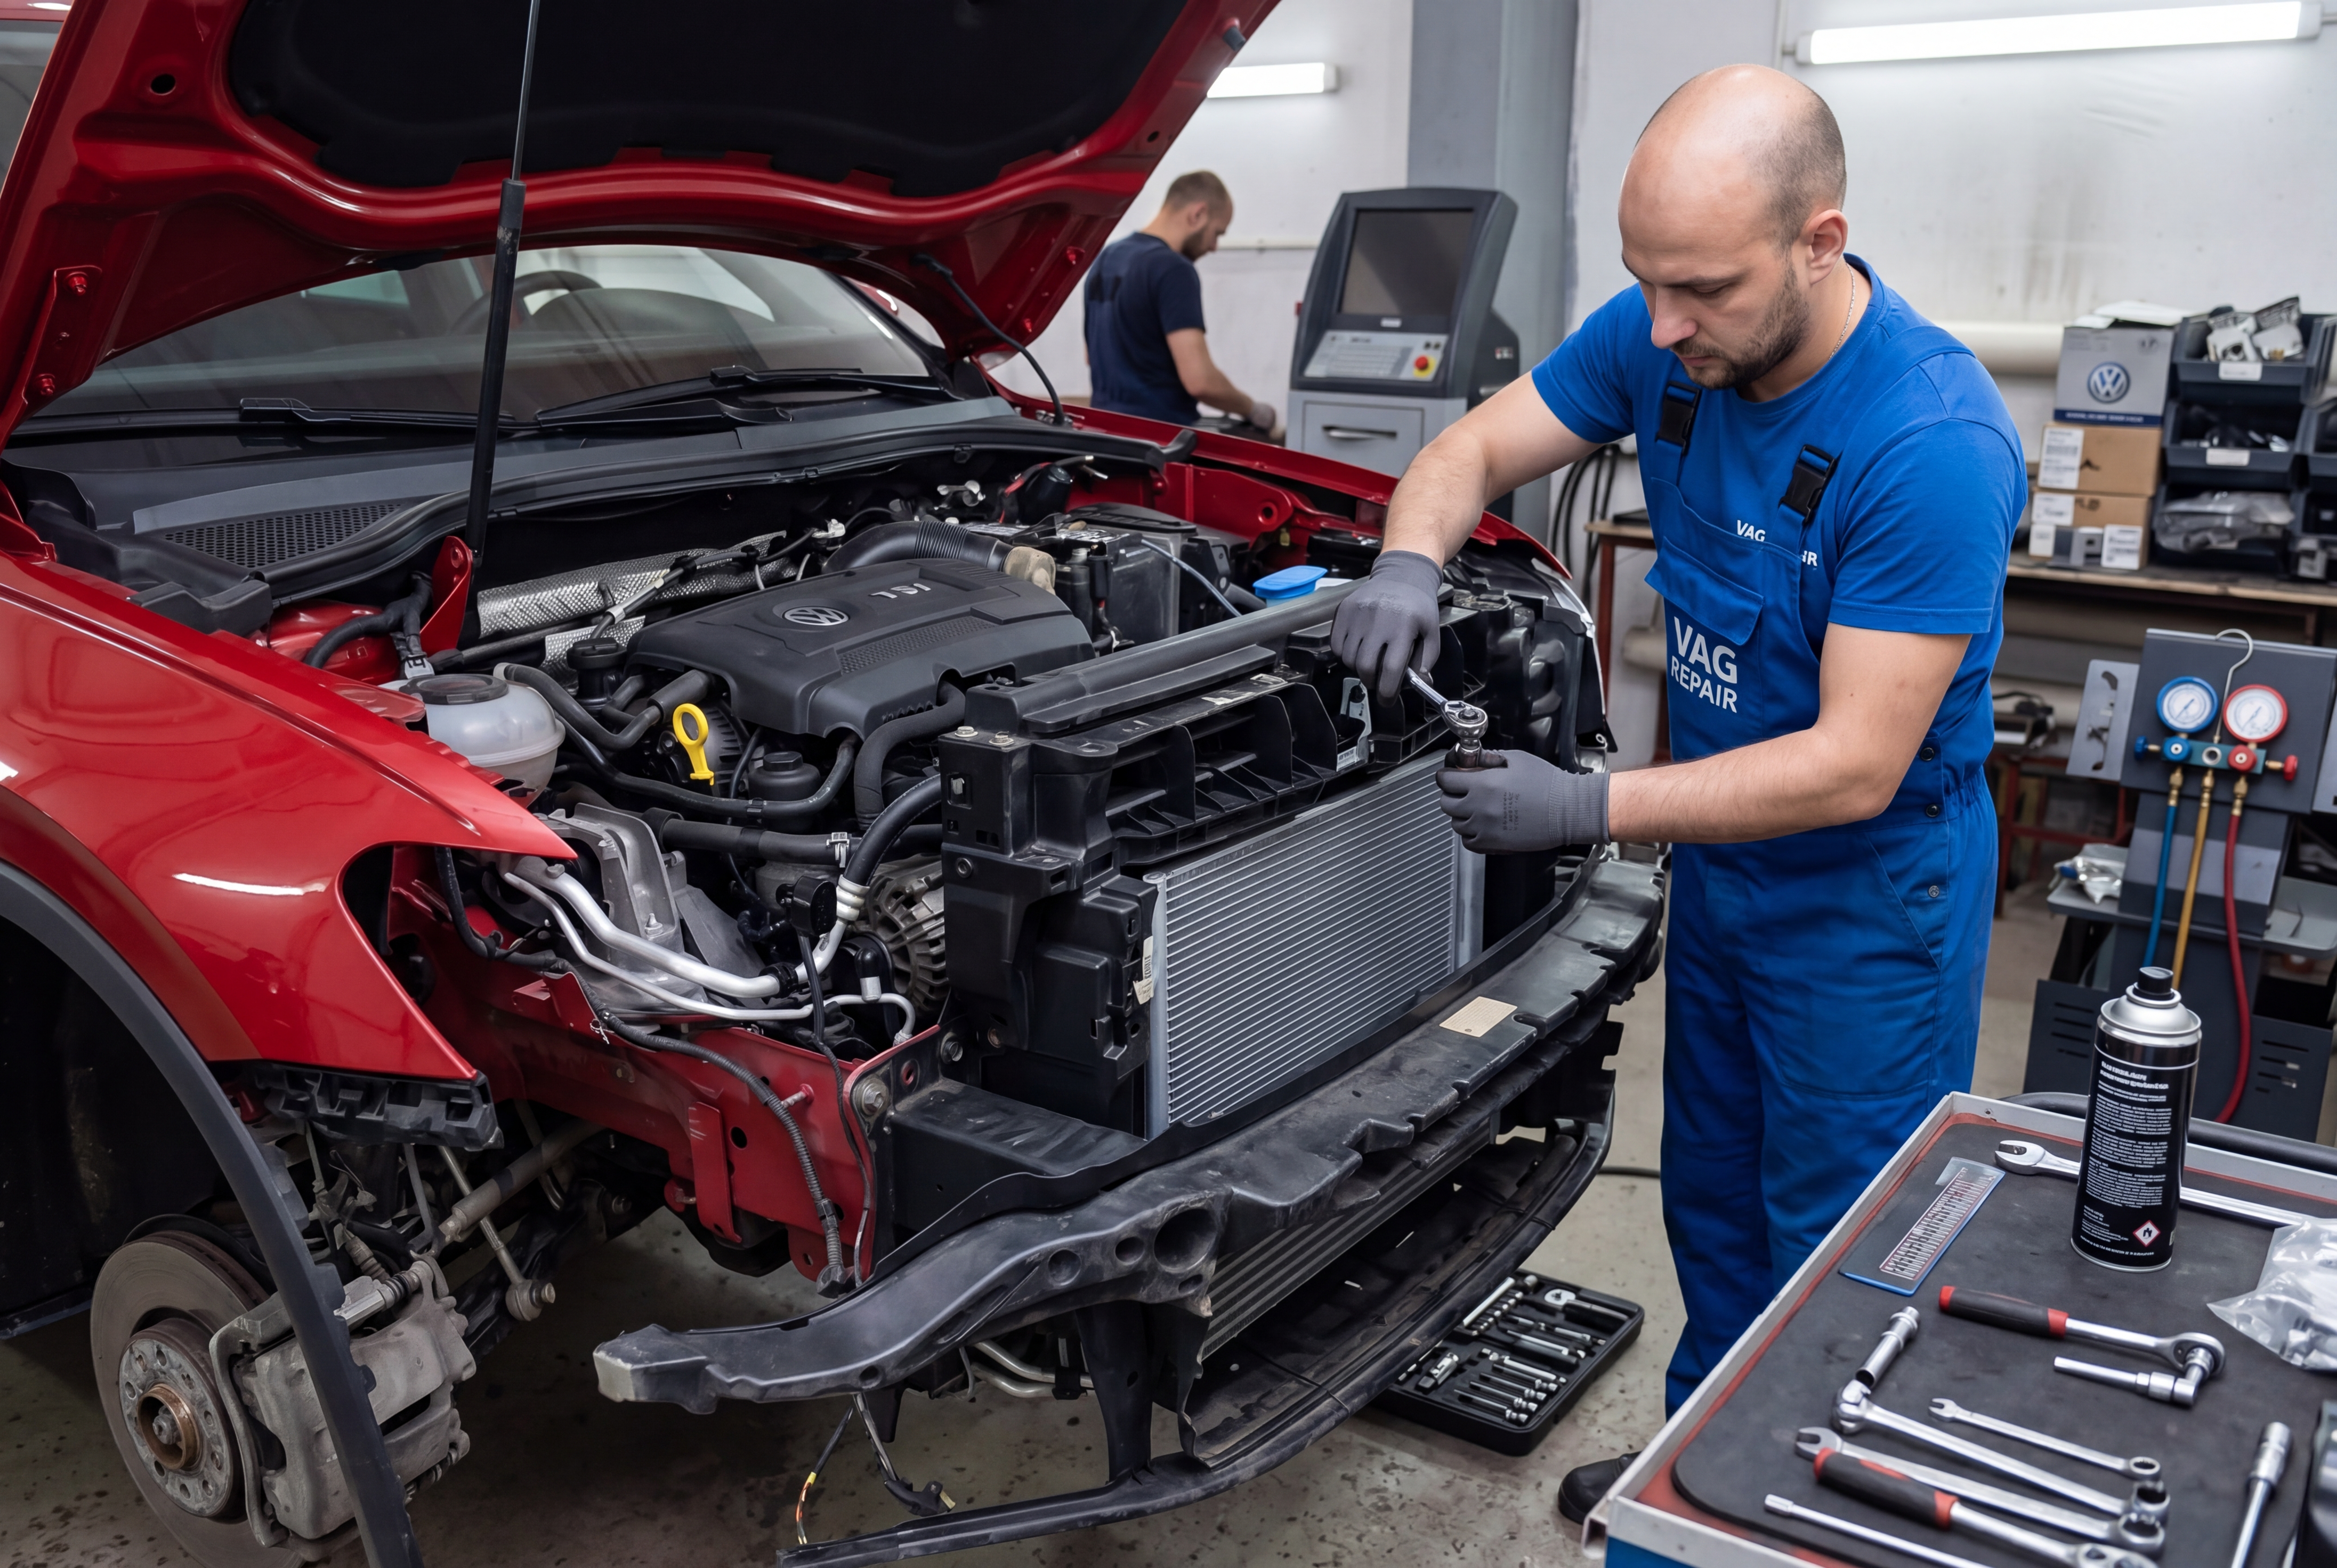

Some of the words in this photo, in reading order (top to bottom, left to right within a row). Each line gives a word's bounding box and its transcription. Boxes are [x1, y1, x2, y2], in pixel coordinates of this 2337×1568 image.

[1737, 520, 1766, 542] VAG
[1673, 616, 1737, 684] VAG
[1671, 655, 1737, 713] REPAIR
